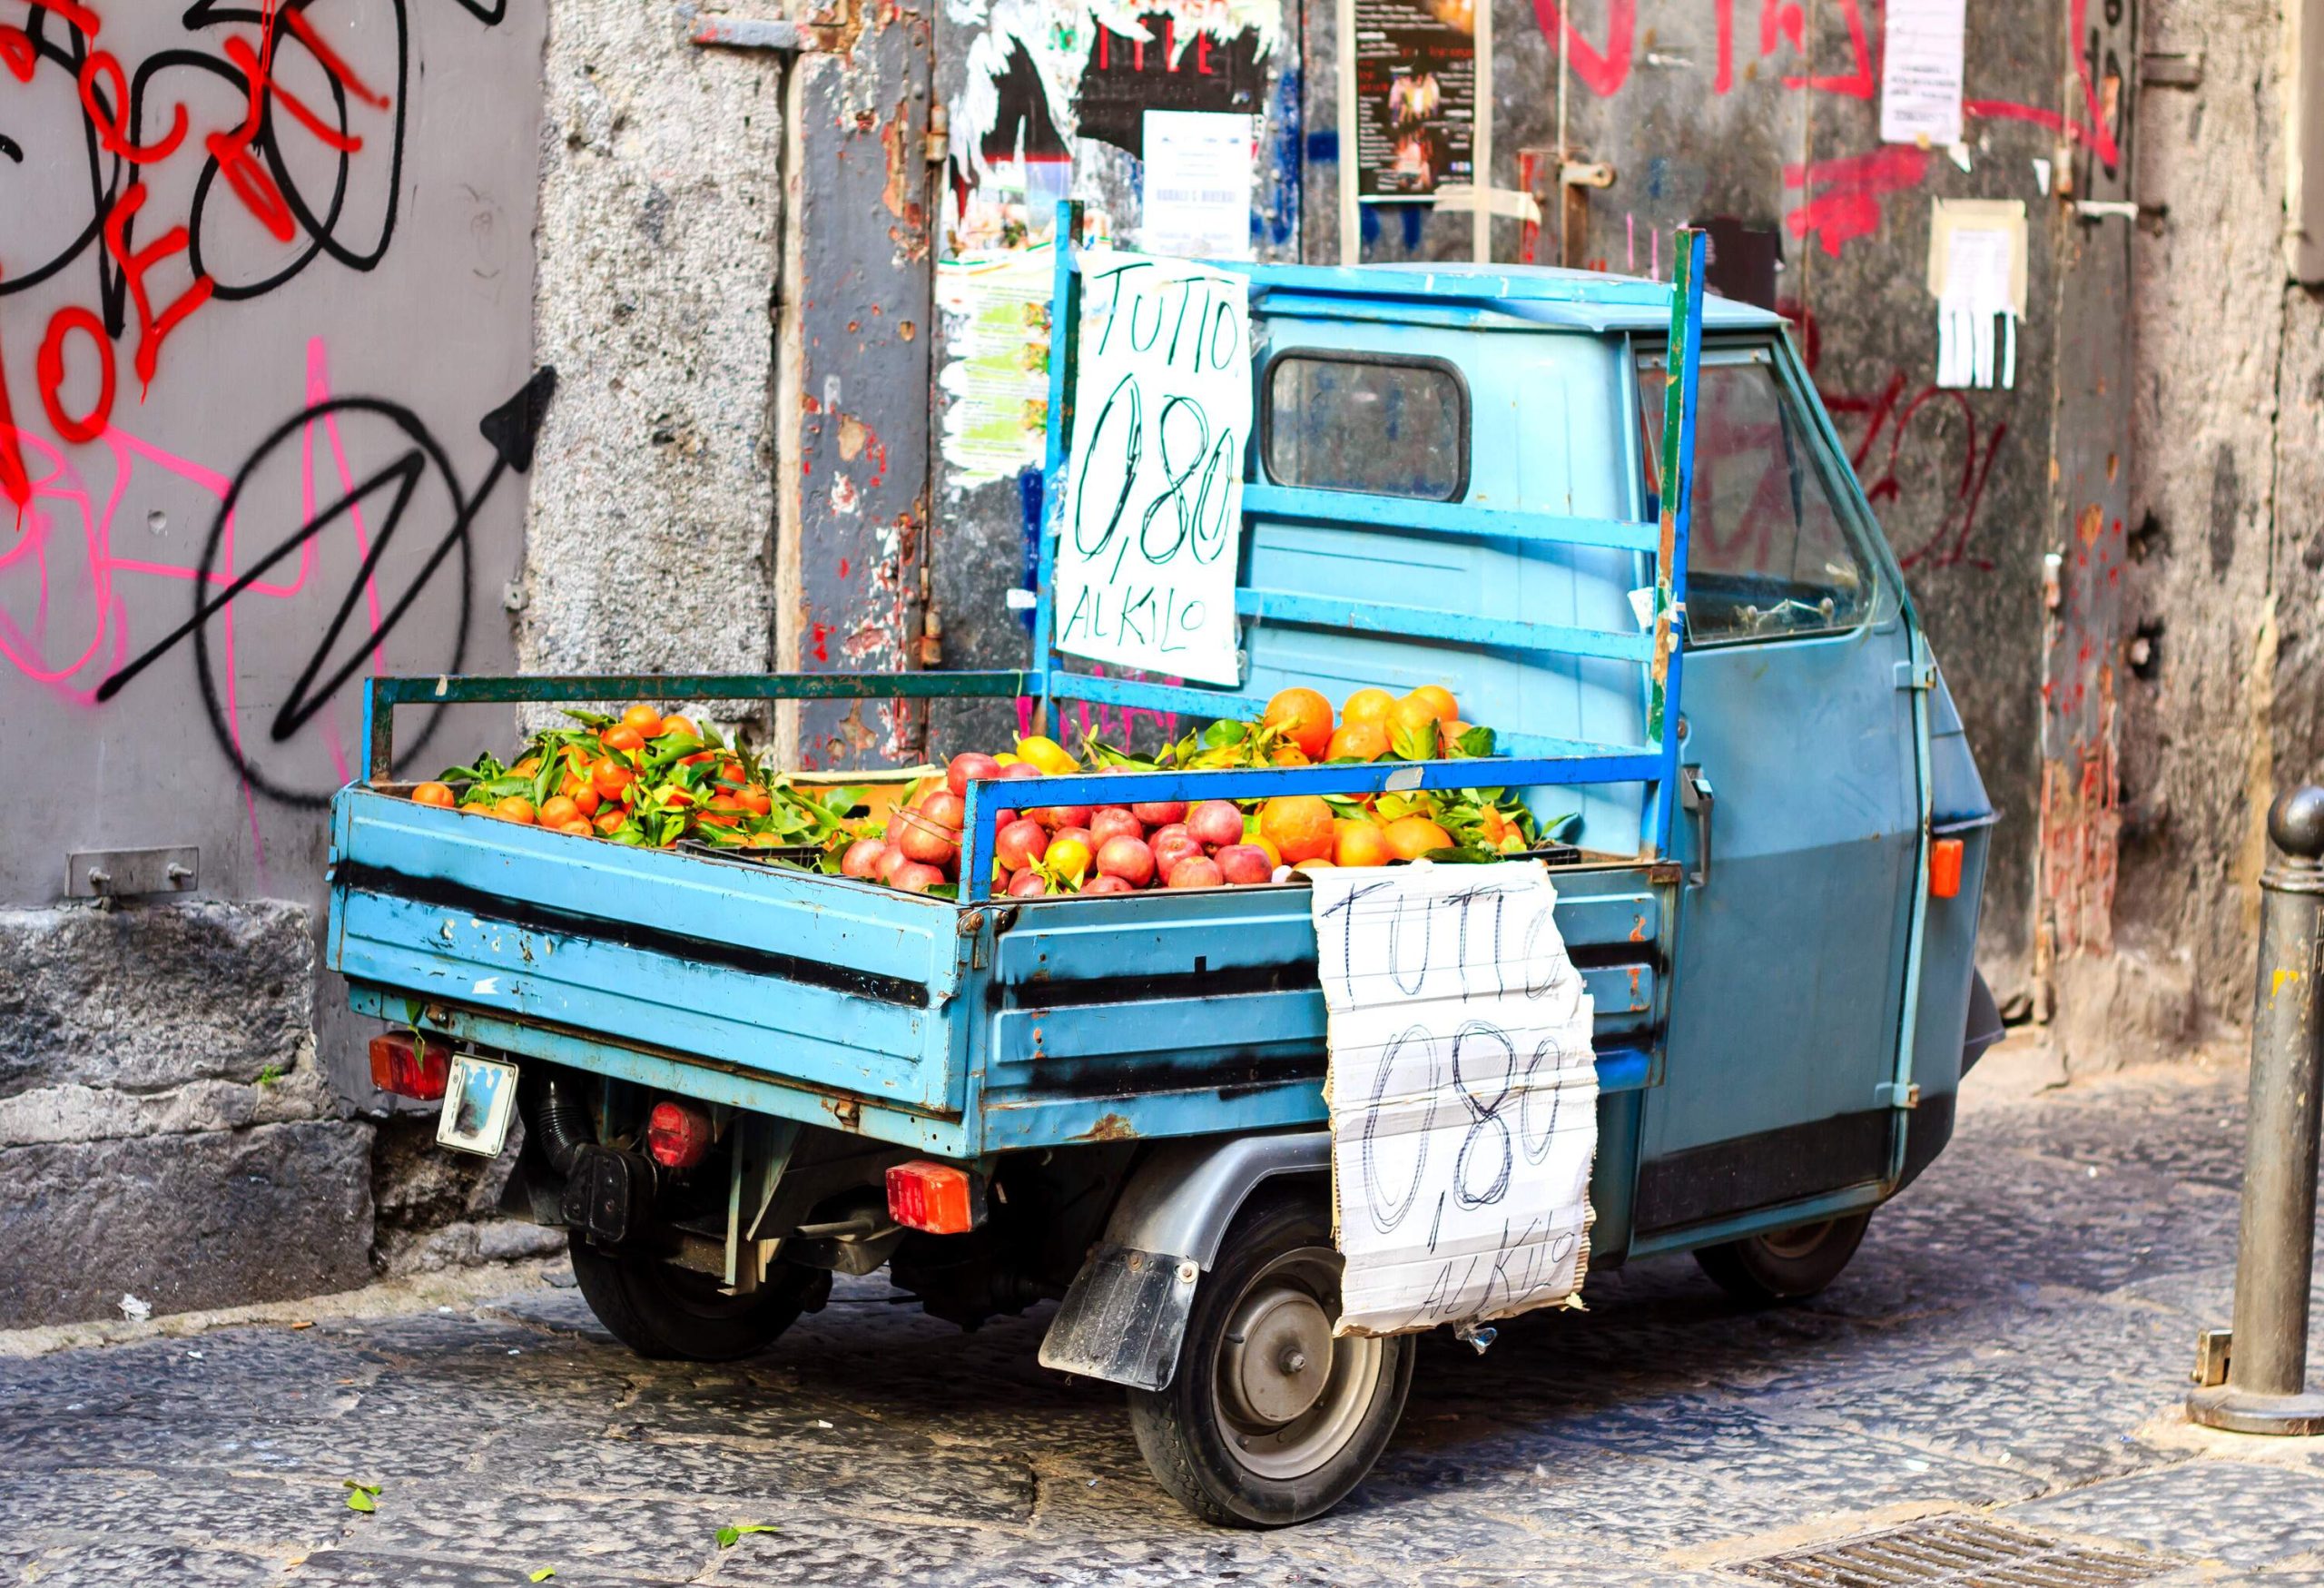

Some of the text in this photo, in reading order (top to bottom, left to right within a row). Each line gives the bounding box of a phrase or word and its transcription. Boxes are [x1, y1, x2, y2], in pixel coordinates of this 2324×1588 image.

[1093, 261, 1238, 374] TUTTO
[1075, 372, 1234, 585] 0,80
[1321, 881, 1562, 1011] TUTTO
[1363, 1019, 1562, 1255] 0,80
